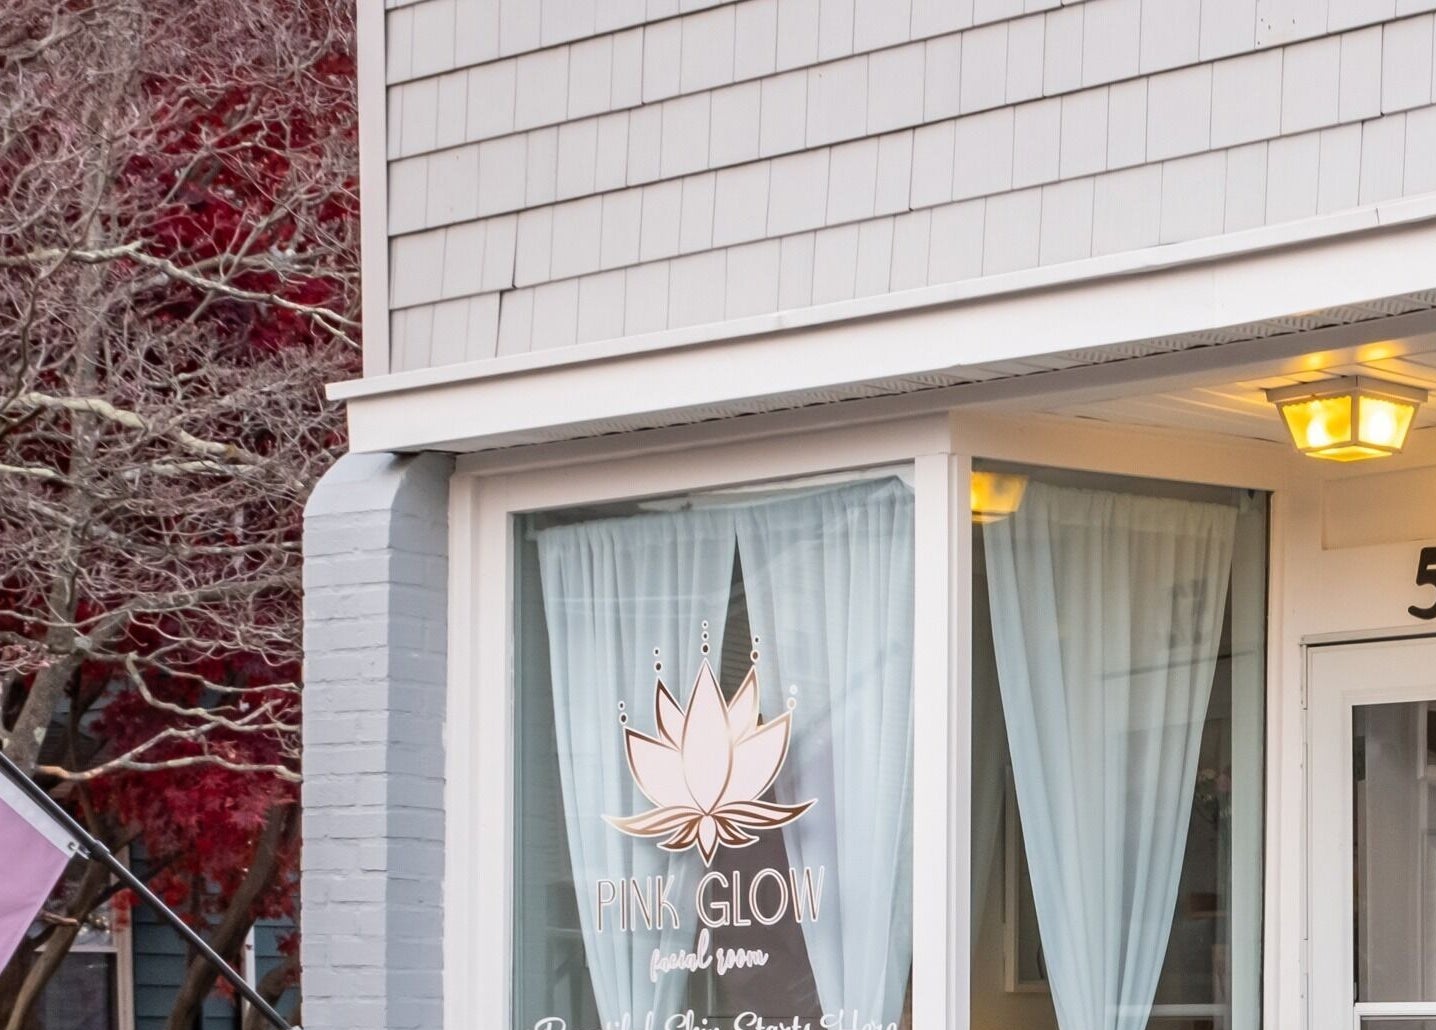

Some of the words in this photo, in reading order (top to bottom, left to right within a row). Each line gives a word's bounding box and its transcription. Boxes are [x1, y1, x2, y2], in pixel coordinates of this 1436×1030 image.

[596, 874, 680, 933] PINK
[695, 865, 825, 929] GLOW
[649, 929, 713, 983] facial
[716, 949, 769, 976] room
